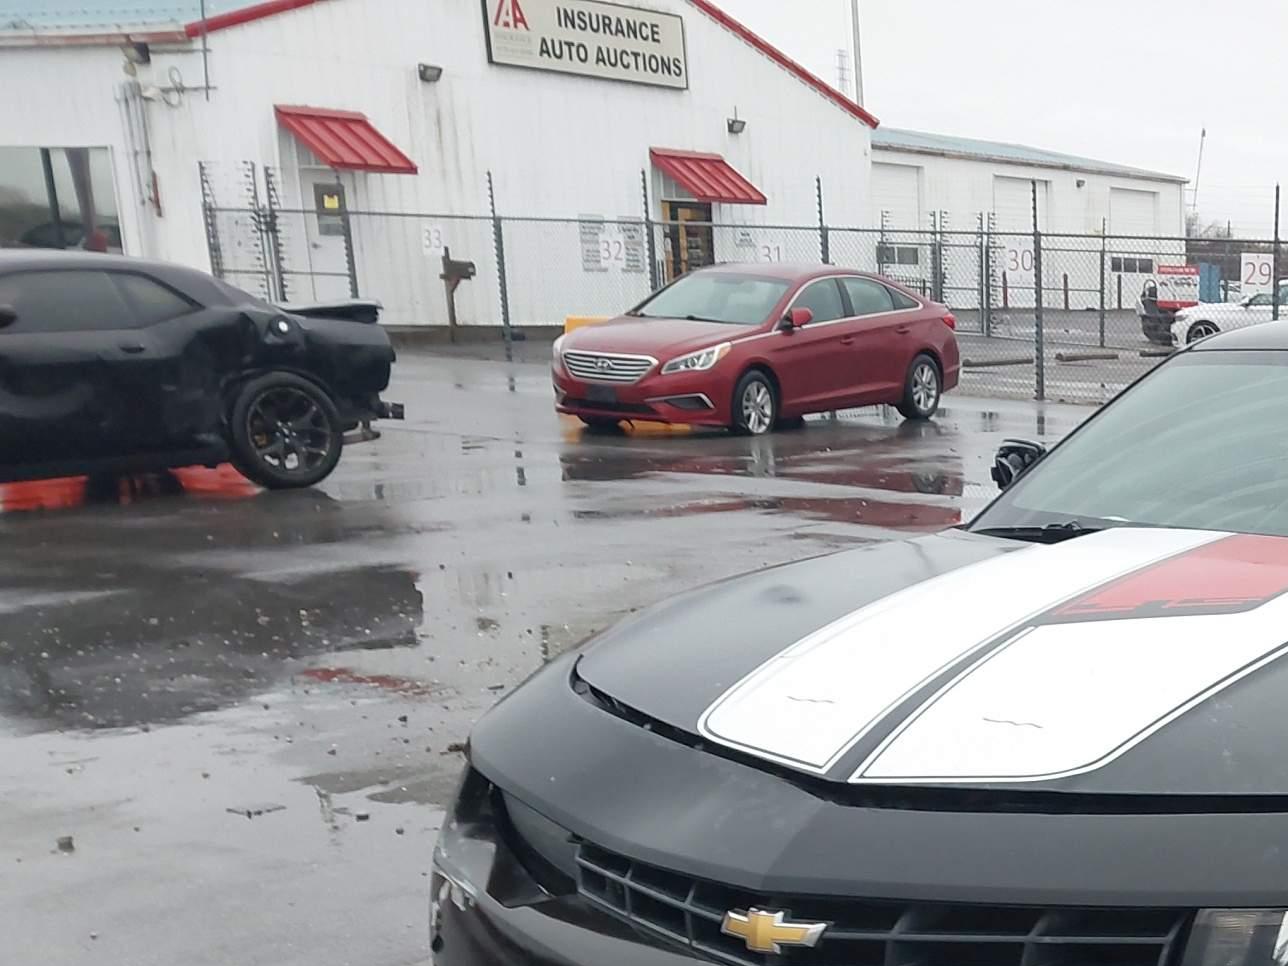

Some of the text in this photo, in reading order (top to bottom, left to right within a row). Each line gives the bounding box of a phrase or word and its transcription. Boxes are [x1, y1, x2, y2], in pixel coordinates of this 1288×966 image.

[556, 6, 661, 44] INSURANCE
[539, 37, 589, 63] AUTO
[595, 46, 682, 77] AUCTIONS
[424, 229, 442, 249] 33
[600, 240, 623, 261] 32
[761, 245, 780, 263] 31
[1008, 248, 1034, 272] 30
[1244, 261, 1272, 286] 29
